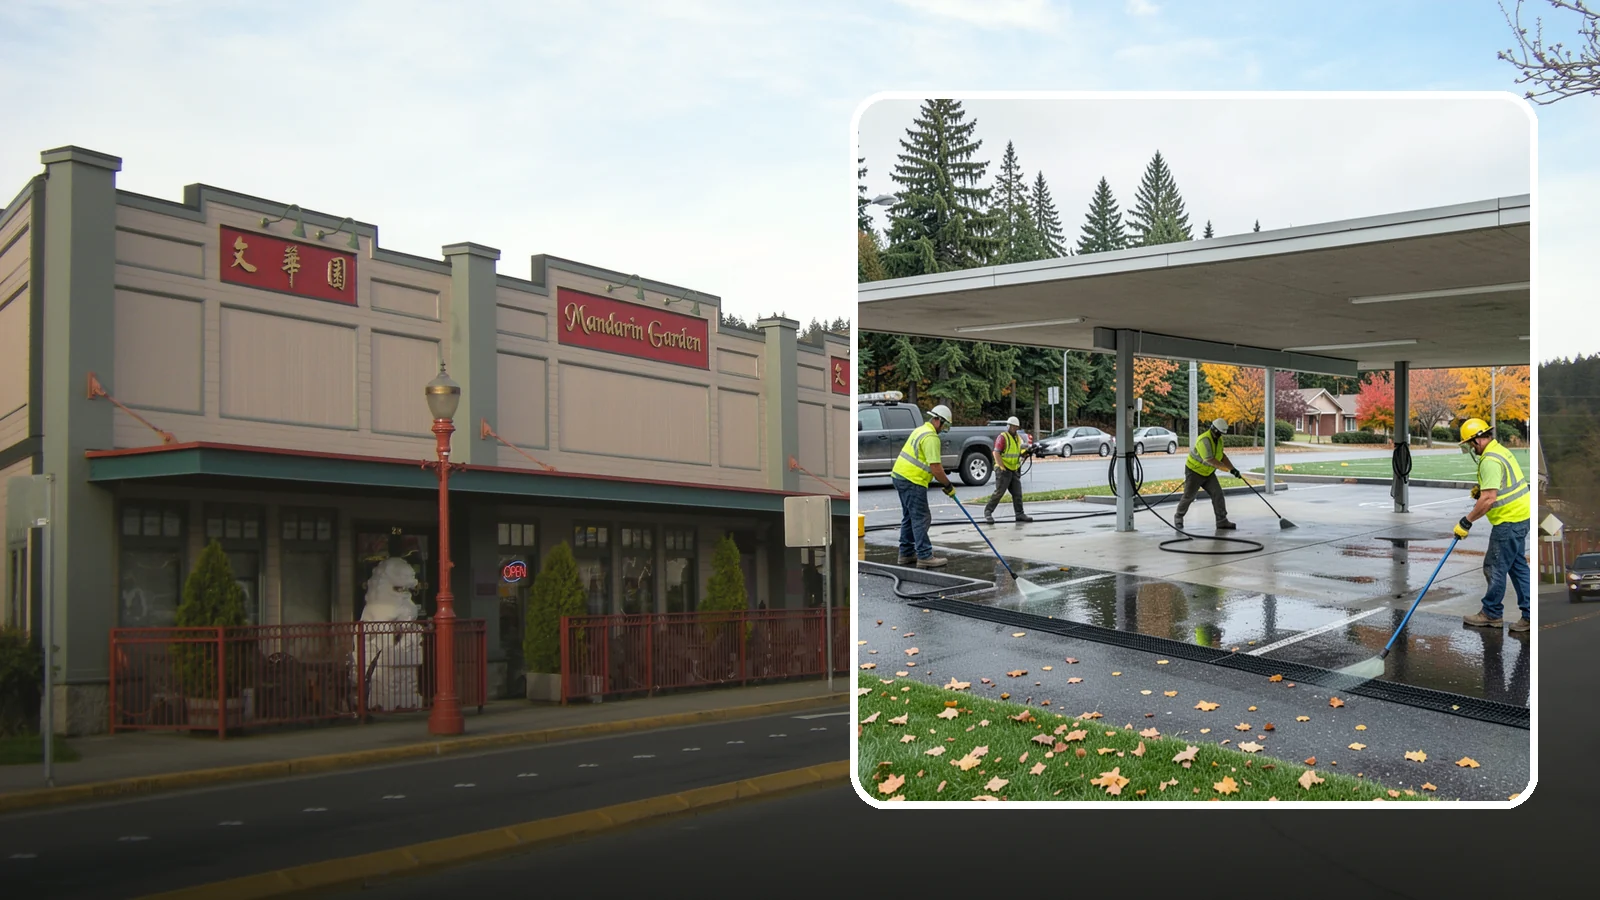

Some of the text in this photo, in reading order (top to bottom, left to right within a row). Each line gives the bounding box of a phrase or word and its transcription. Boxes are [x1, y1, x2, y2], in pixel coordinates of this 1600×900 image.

[231, 236, 346, 291] 文華園
[564, 302, 701, 352] Mandarin Garden
[503, 565, 527, 578] OPEN
